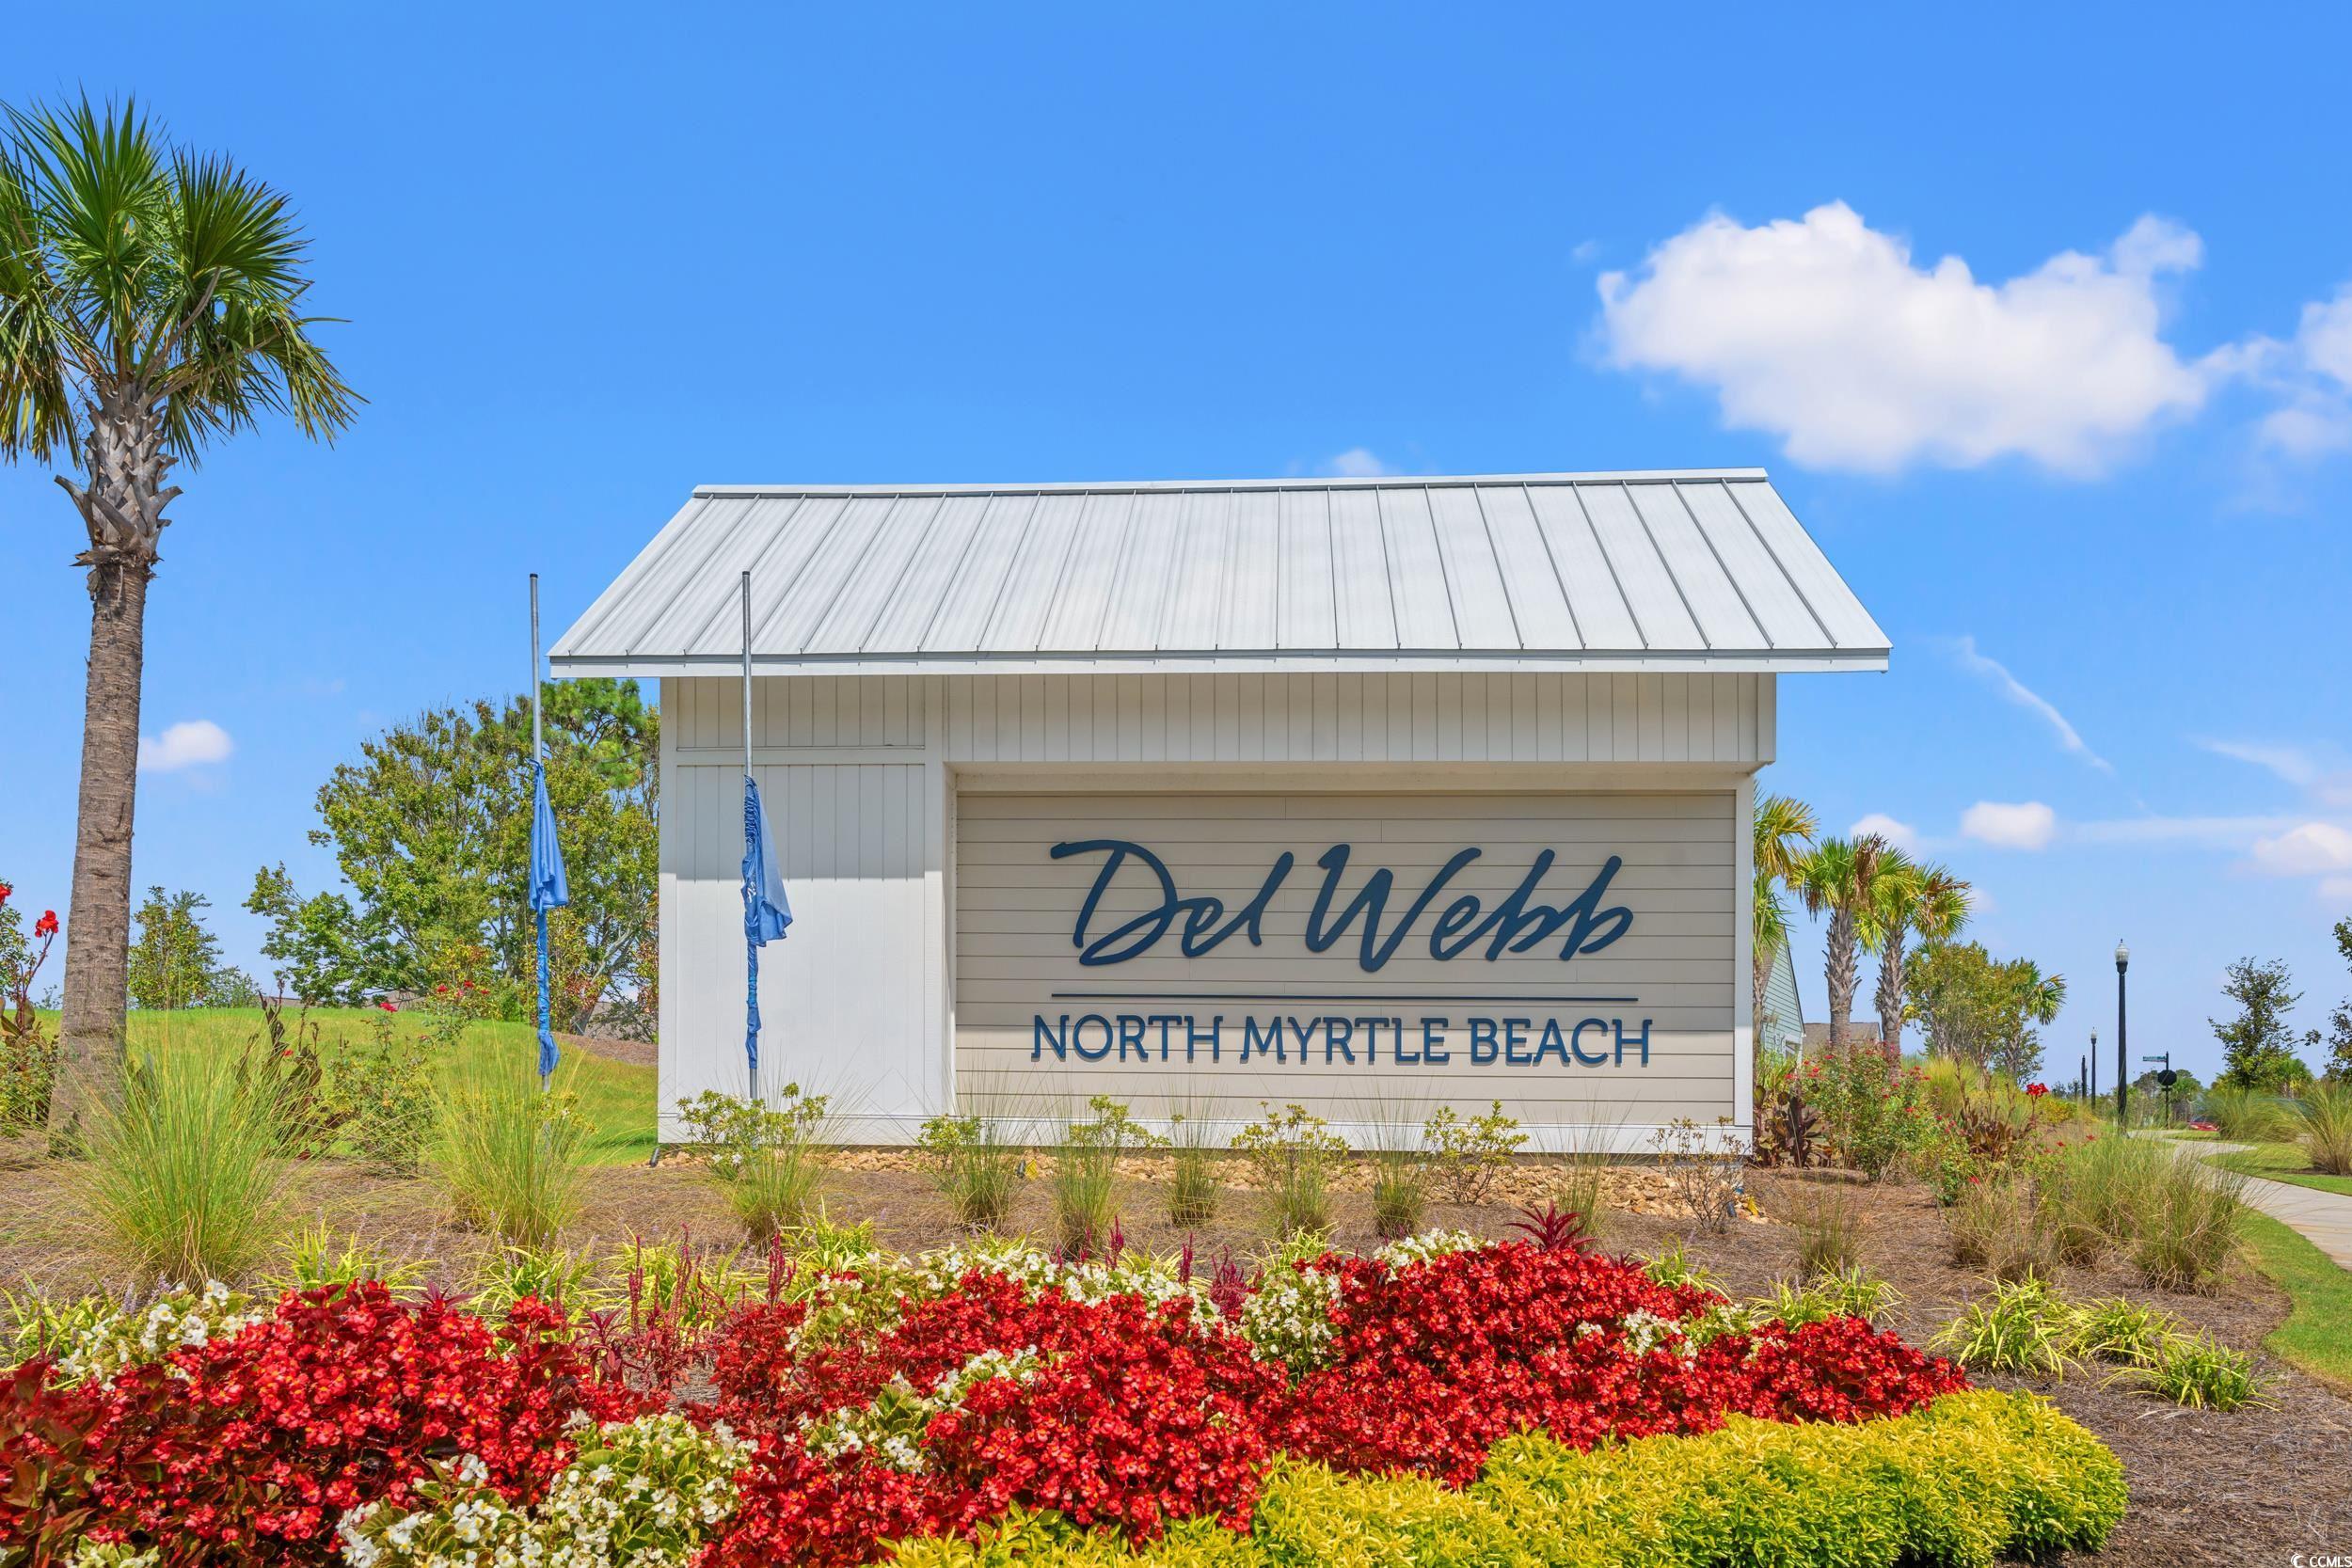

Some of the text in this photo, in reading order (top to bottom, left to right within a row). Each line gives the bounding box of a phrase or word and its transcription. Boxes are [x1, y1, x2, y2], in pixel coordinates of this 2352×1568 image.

[1050, 839, 1634, 973] Del Webb
[1031, 1014, 1653, 1066] NORTH MYRTLE BEACH
